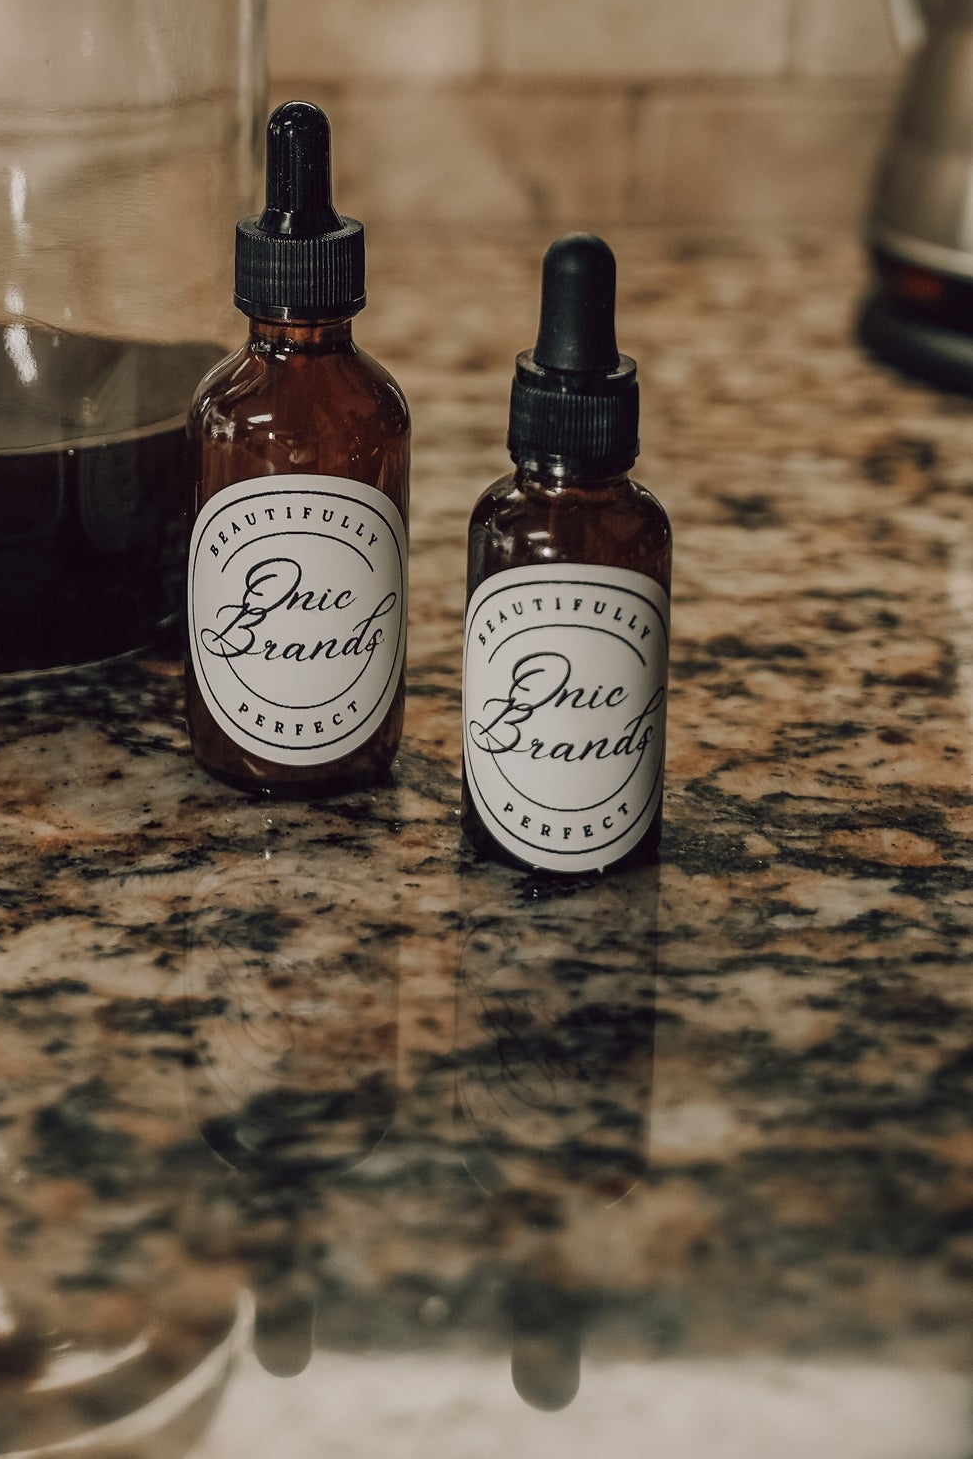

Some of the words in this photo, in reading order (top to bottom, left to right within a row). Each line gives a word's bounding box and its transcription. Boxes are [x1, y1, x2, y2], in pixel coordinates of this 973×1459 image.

[209, 506, 379, 558] BEAUTIFULLY
[200, 592, 397, 662] Brands
[478, 597, 651, 646] BEAUTIFULLY
[238, 700, 359, 736] PERFECT
[469, 686, 666, 763] Brands
[503, 802, 632, 840] PERFECT
